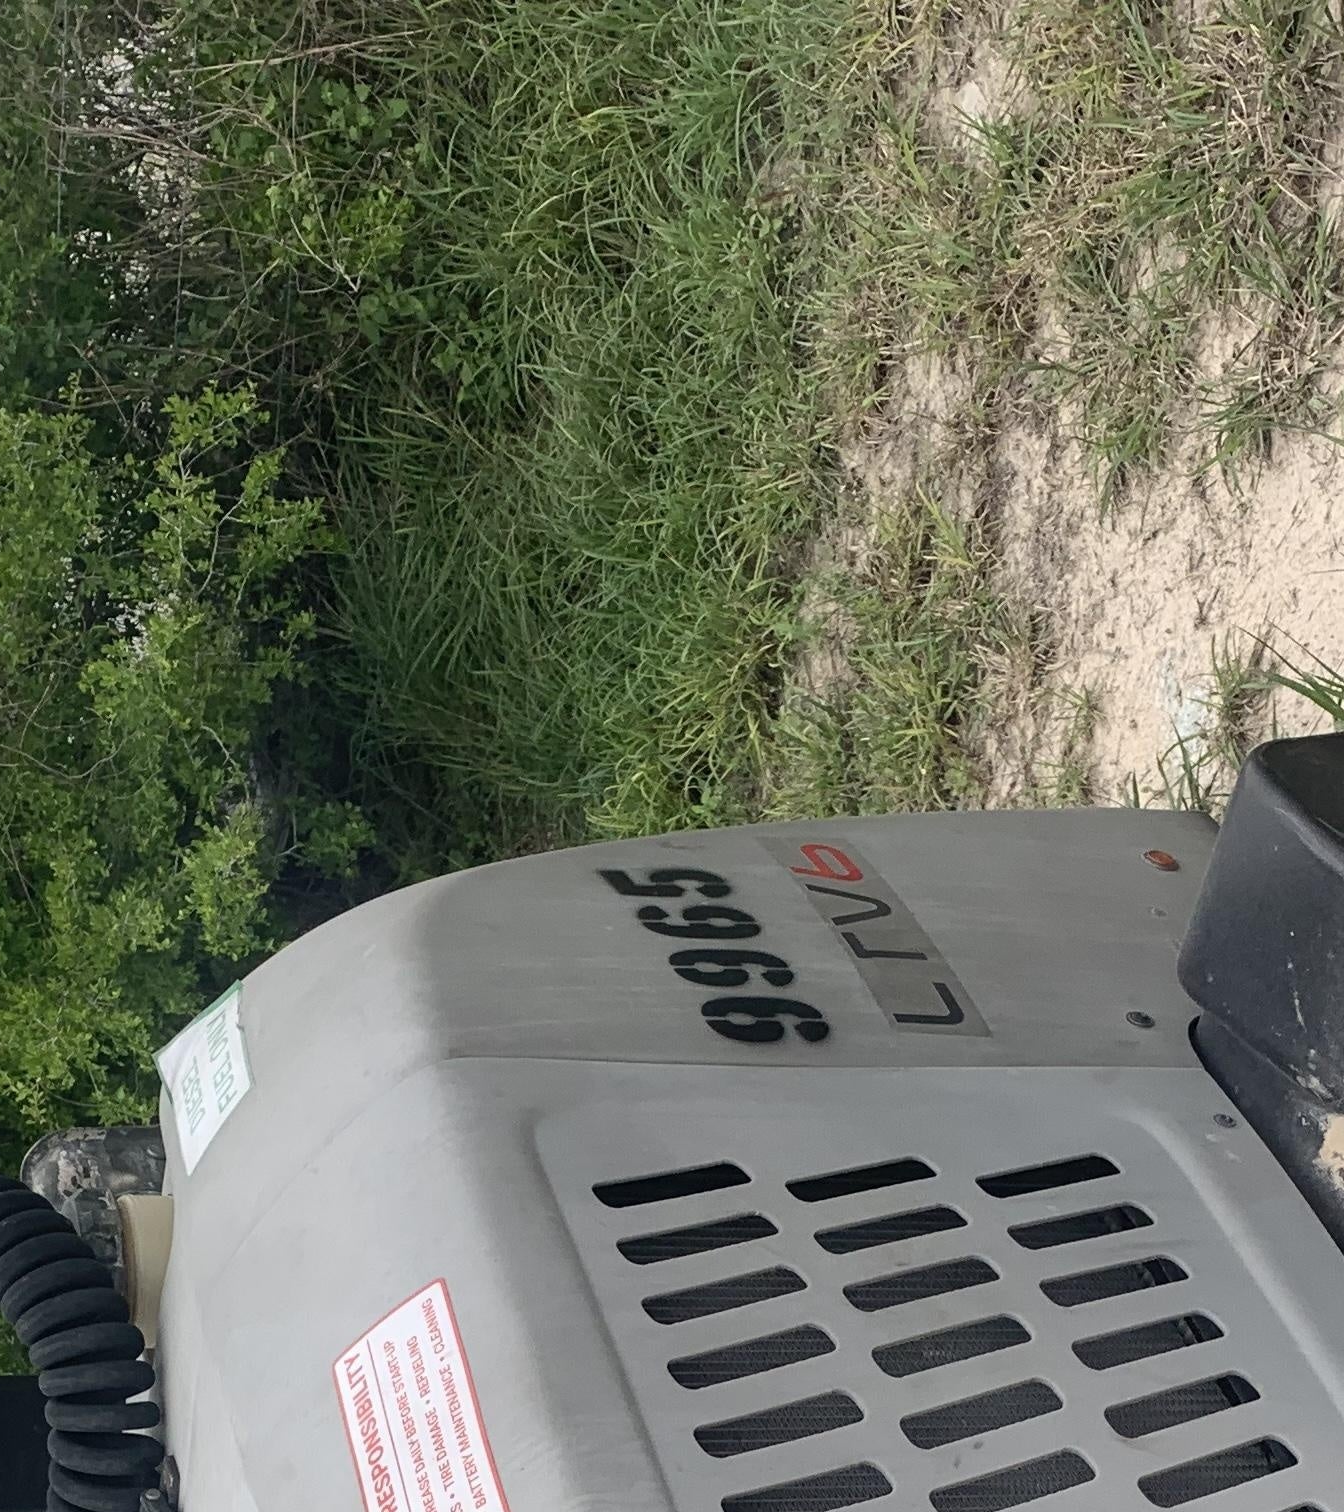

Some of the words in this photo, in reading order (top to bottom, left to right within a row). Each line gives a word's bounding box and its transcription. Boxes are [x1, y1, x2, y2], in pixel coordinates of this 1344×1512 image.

[596, 867, 831, 1045] 9965
[182, 1055, 206, 1136] DIESEL
[213, 1050, 237, 1113] FUEL
[420, 1297, 447, 1355] CLEANING
[382, 1339, 406, 1396] START-UP
[406, 1335, 431, 1397] REFUELING
[396, 1392, 419, 1440] BEFORE
[424, 1407, 448, 1462] DAMAGE
[439, 1364, 473, 1454] MAINTENANCE
[407, 1440, 428, 1475] DAILY
[436, 1463, 455, 1491] TIRE
[461, 1453, 488, 1509] BATTERY
